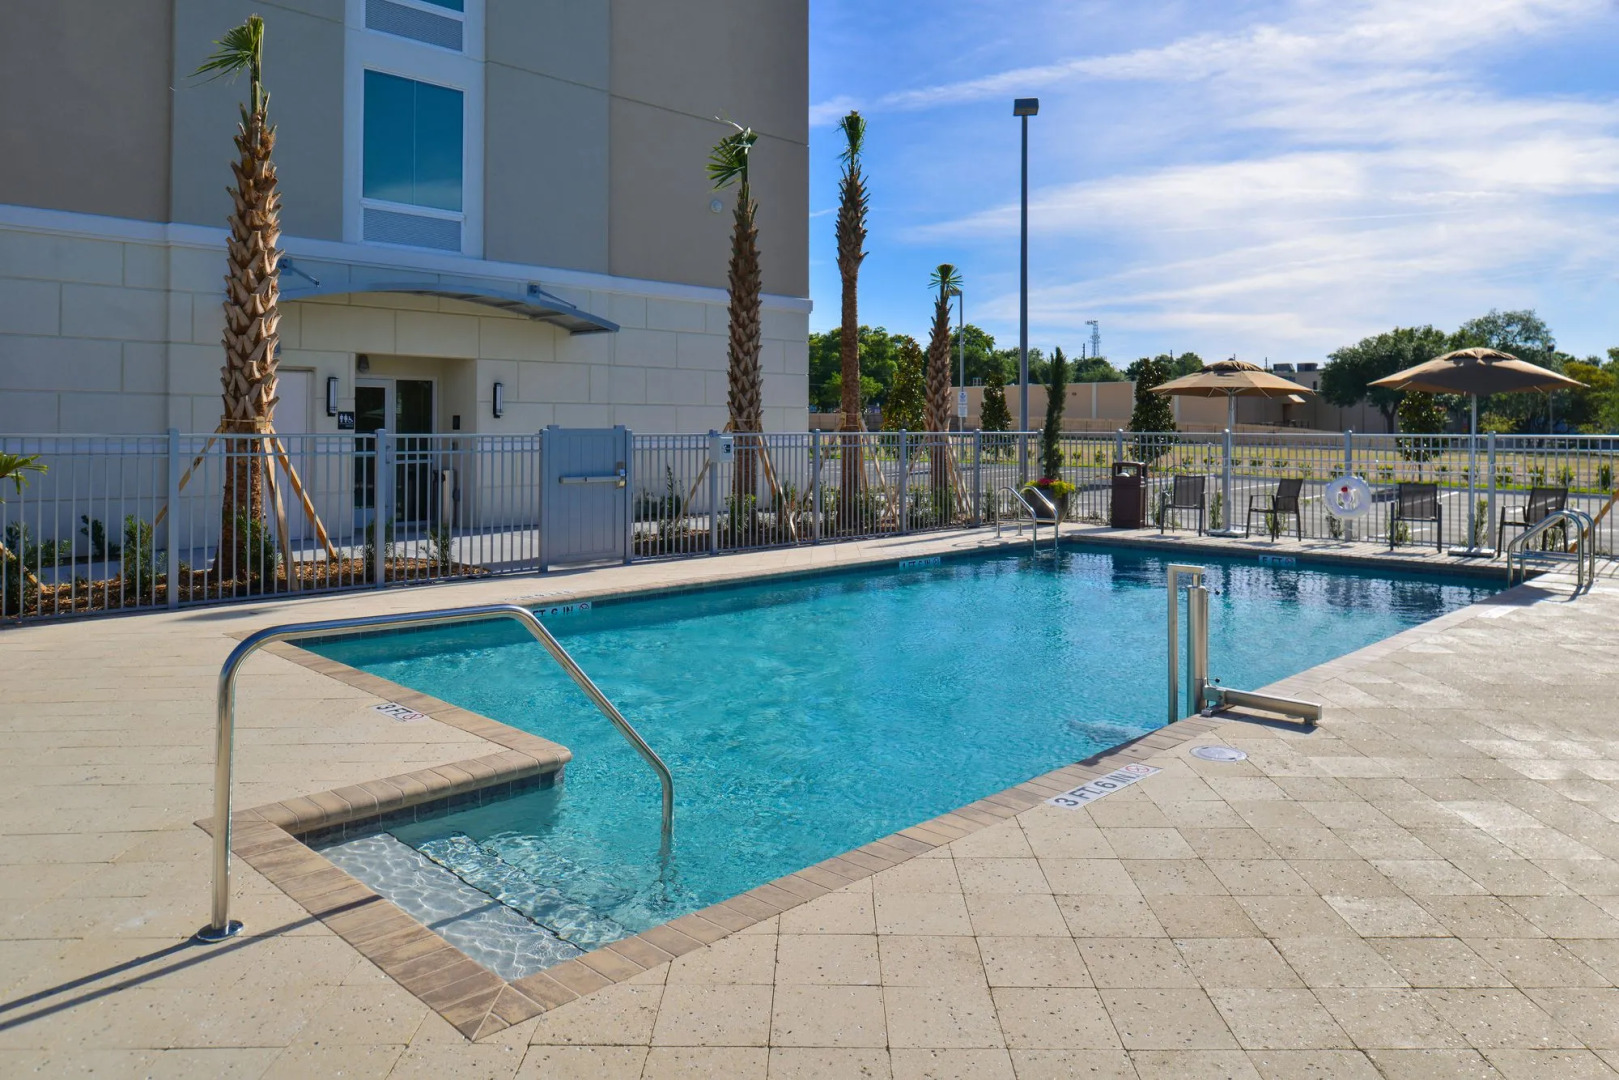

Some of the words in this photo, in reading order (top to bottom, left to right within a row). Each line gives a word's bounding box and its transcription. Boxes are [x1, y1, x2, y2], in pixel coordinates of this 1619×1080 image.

[563, 606, 574, 616] IN
[1054, 797, 1079, 806] 3
[1094, 780, 1117, 789] 6
